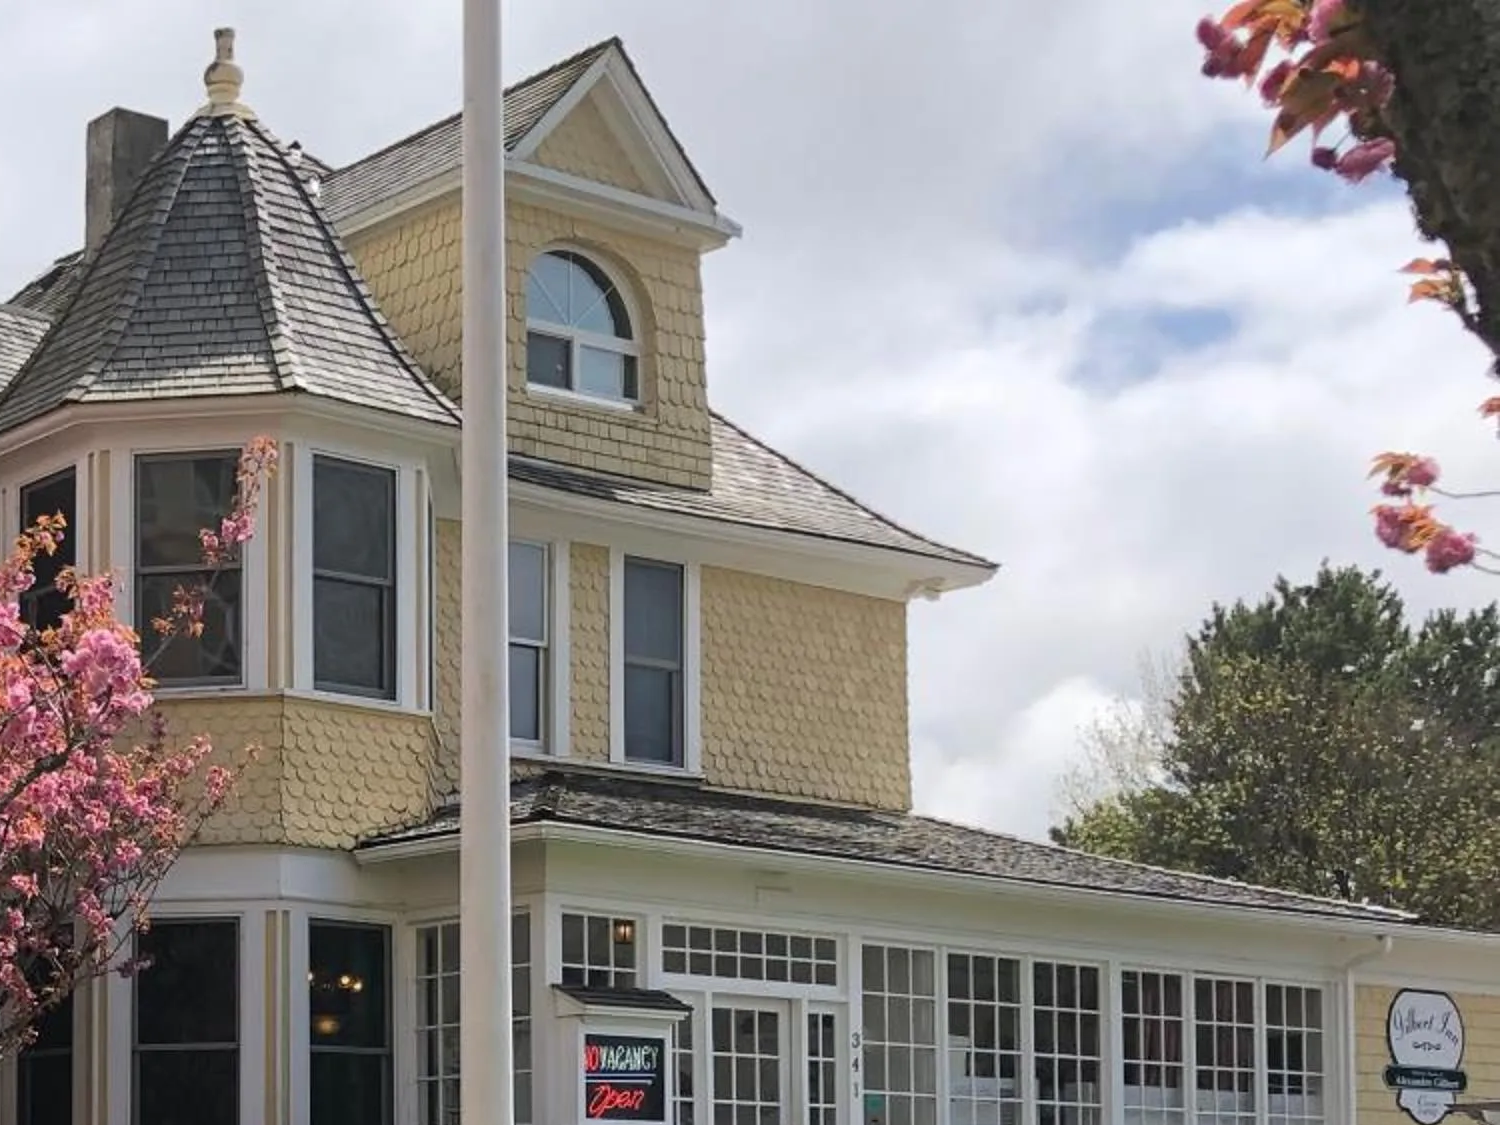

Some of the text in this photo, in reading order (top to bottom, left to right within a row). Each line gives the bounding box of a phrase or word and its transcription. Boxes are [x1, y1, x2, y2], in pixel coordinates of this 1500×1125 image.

[1393, 1006, 1435, 1041] Gilbert
[599, 1045, 659, 1071] VACANCY
[589, 1085, 645, 1119] Open
